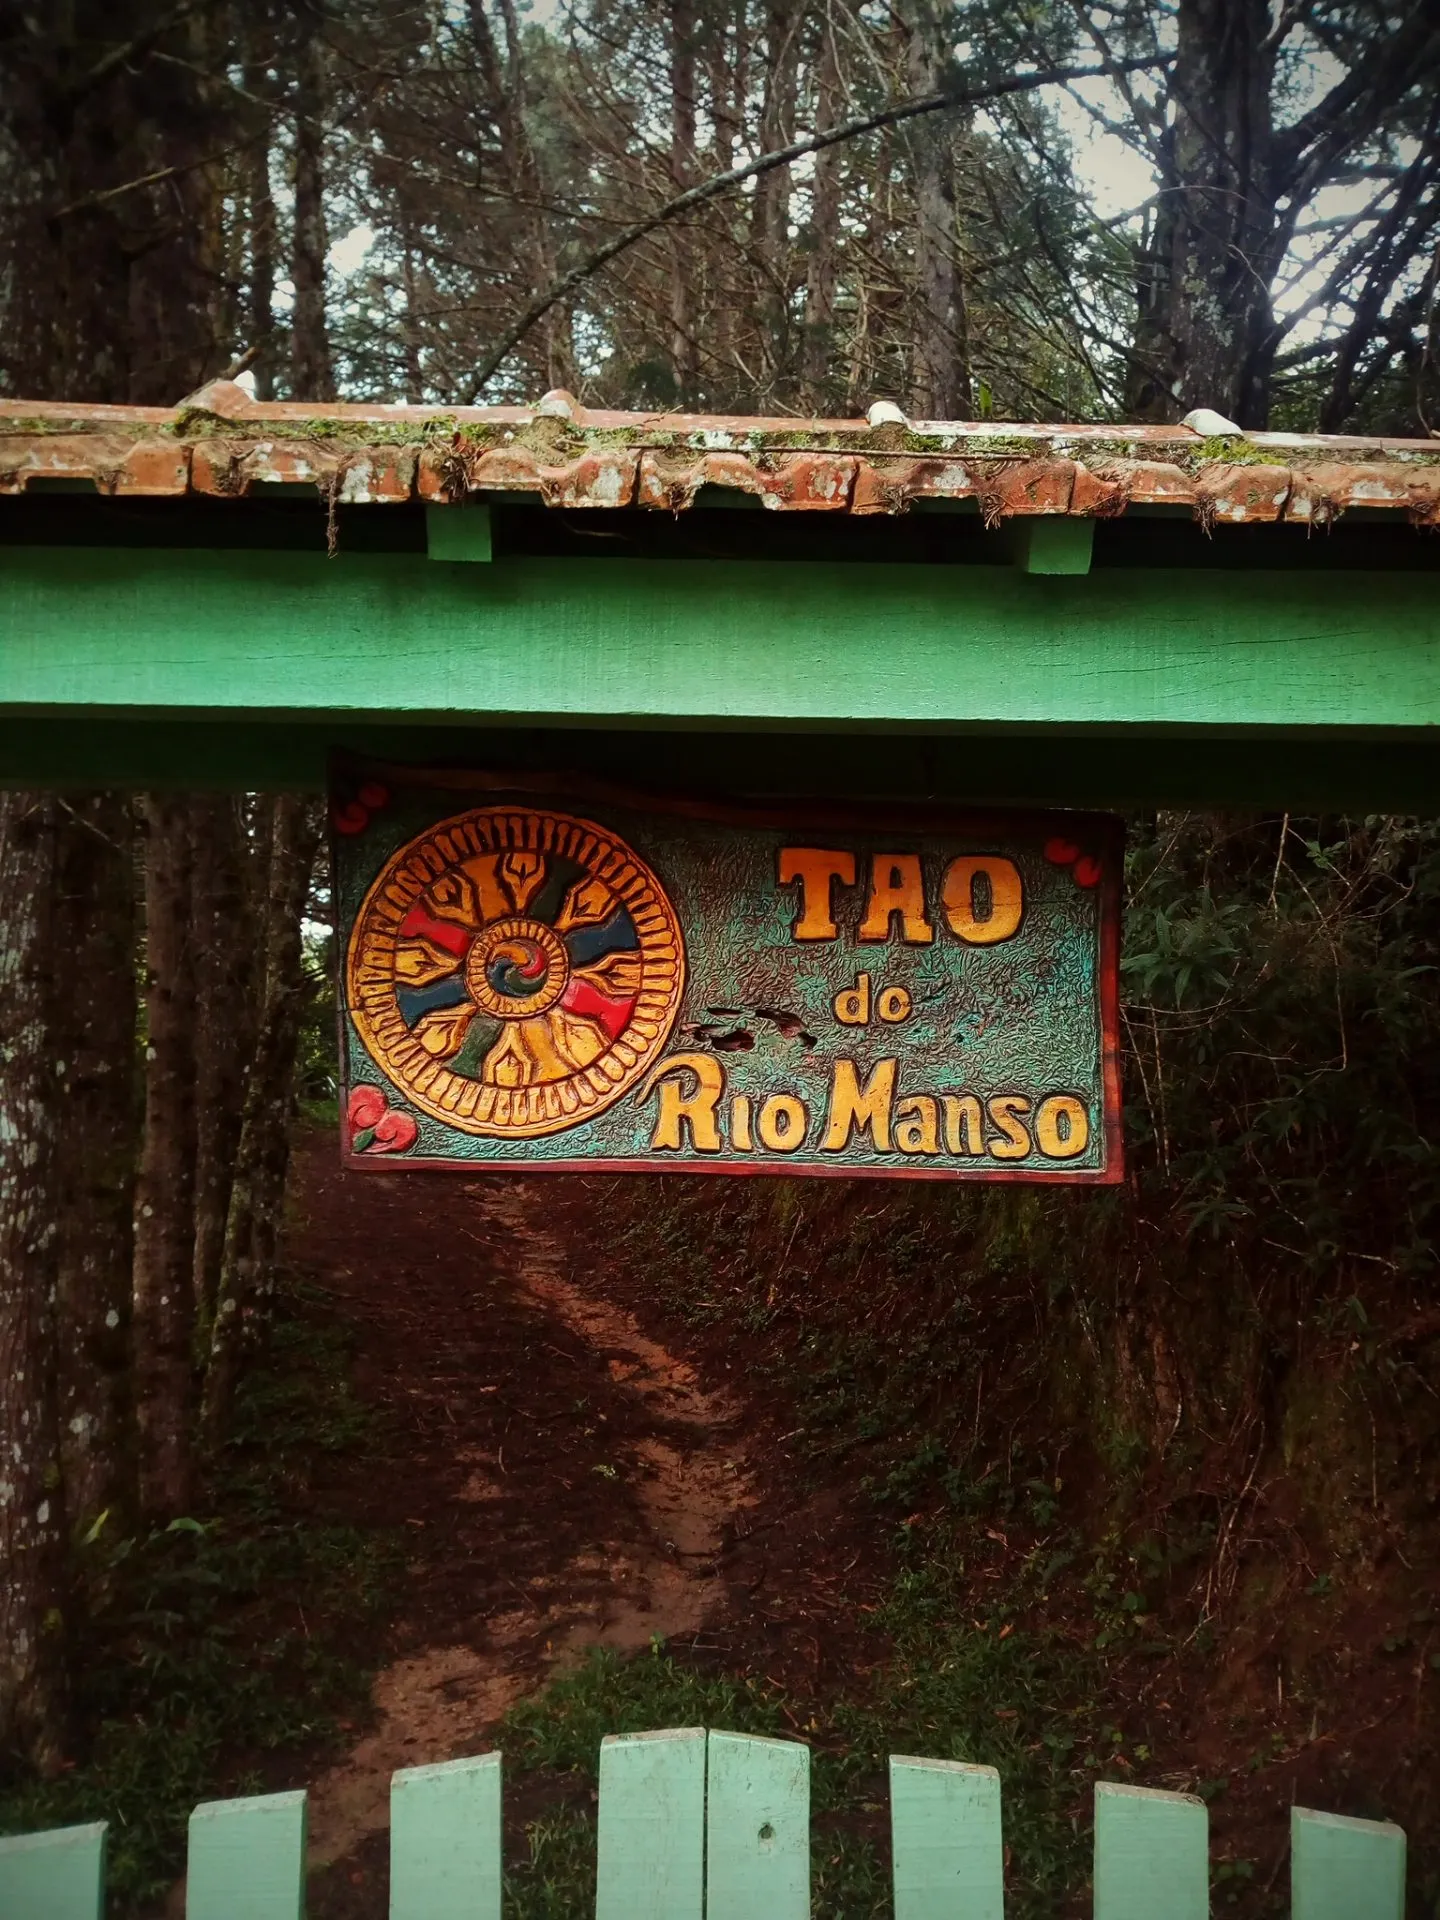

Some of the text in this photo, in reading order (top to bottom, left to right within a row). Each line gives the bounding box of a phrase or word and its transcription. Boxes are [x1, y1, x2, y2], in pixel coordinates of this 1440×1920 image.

[779, 847, 1023, 944] TAO
[834, 973, 912, 1025] do
[637, 1053, 1088, 1158] Rio Manso
